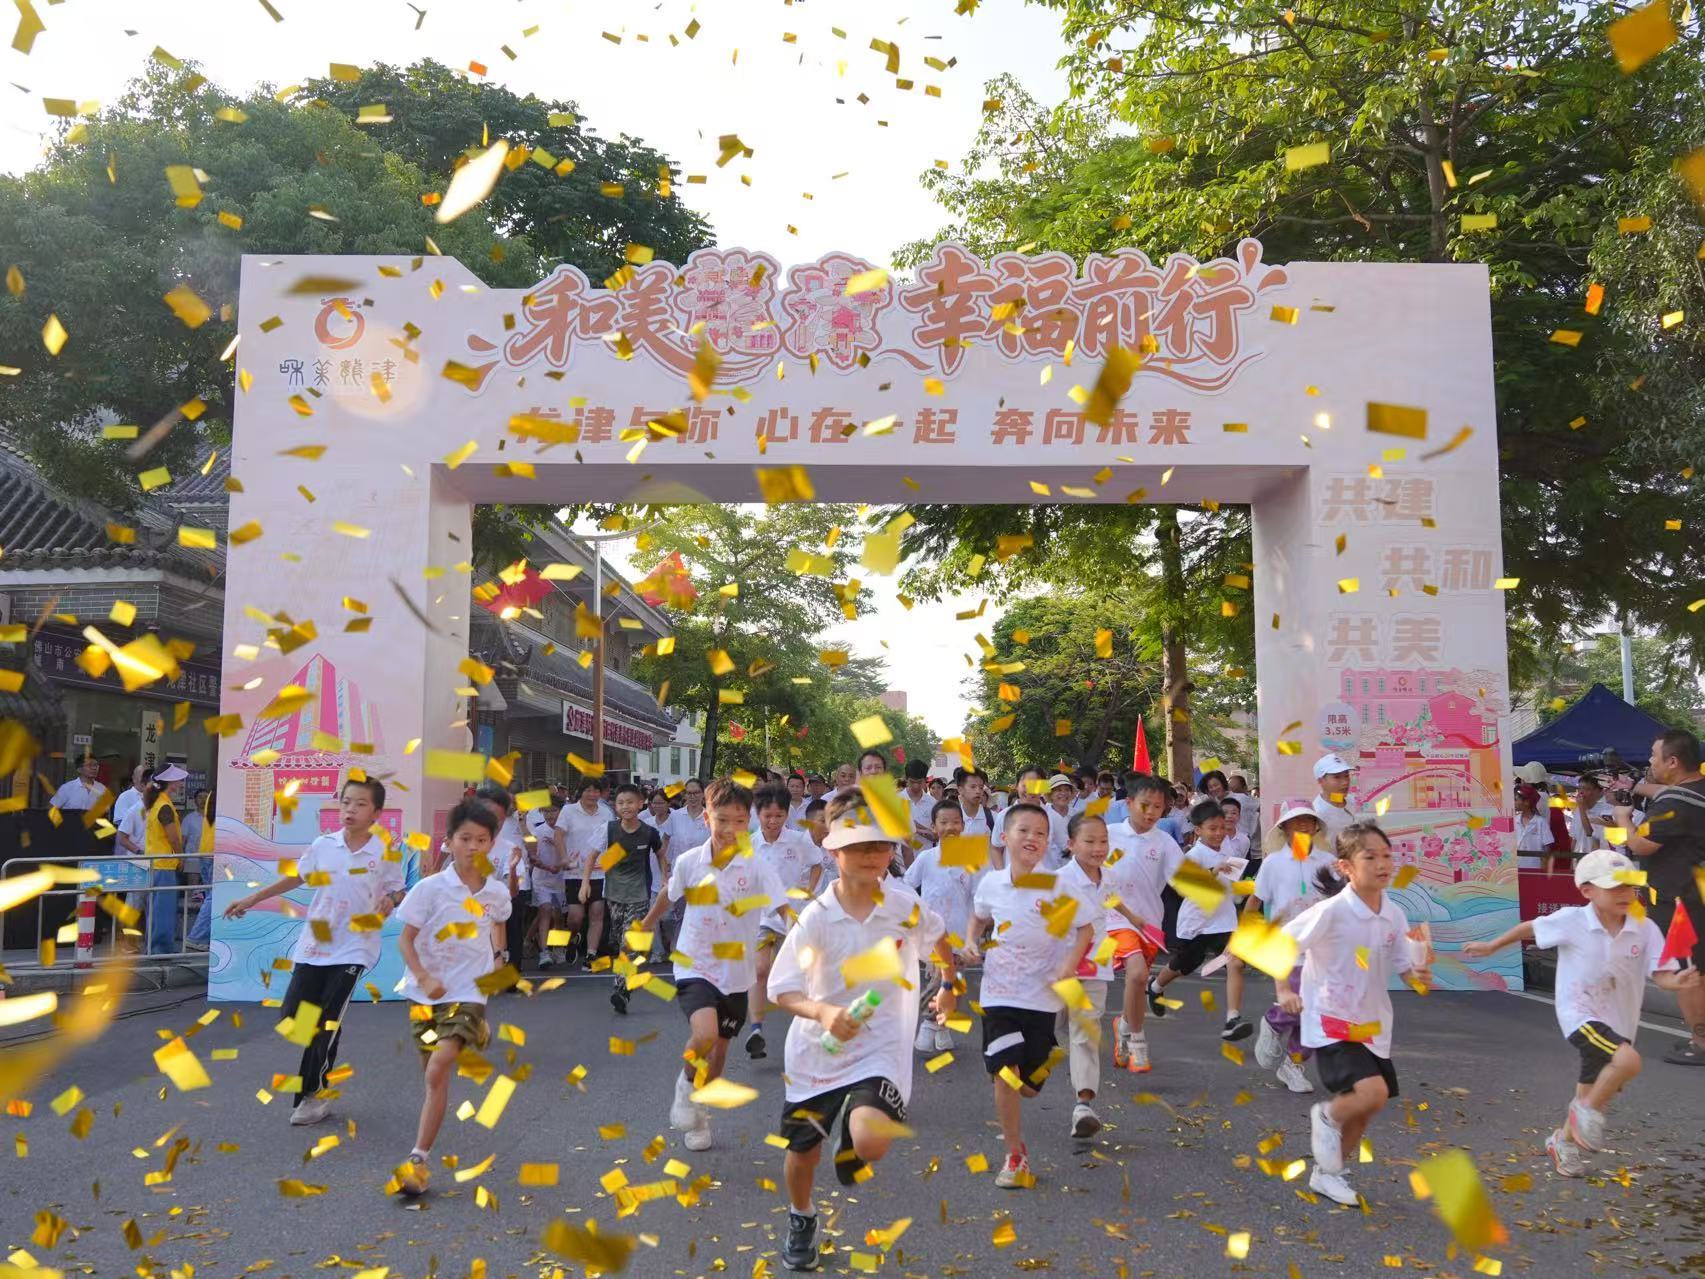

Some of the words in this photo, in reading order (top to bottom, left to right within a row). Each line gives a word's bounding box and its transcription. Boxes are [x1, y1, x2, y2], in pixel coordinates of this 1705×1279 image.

[903, 250, 1256, 372] 幸福前行
[991, 408, 1193, 445] 奔向未来
[1322, 478, 1433, 521] 共建
[1382, 547, 1493, 591] 共和
[1328, 617, 1440, 662] 共美
[1324, 726, 1352, 736] 3.5米
[1327, 713, 1348, 724] 限高
